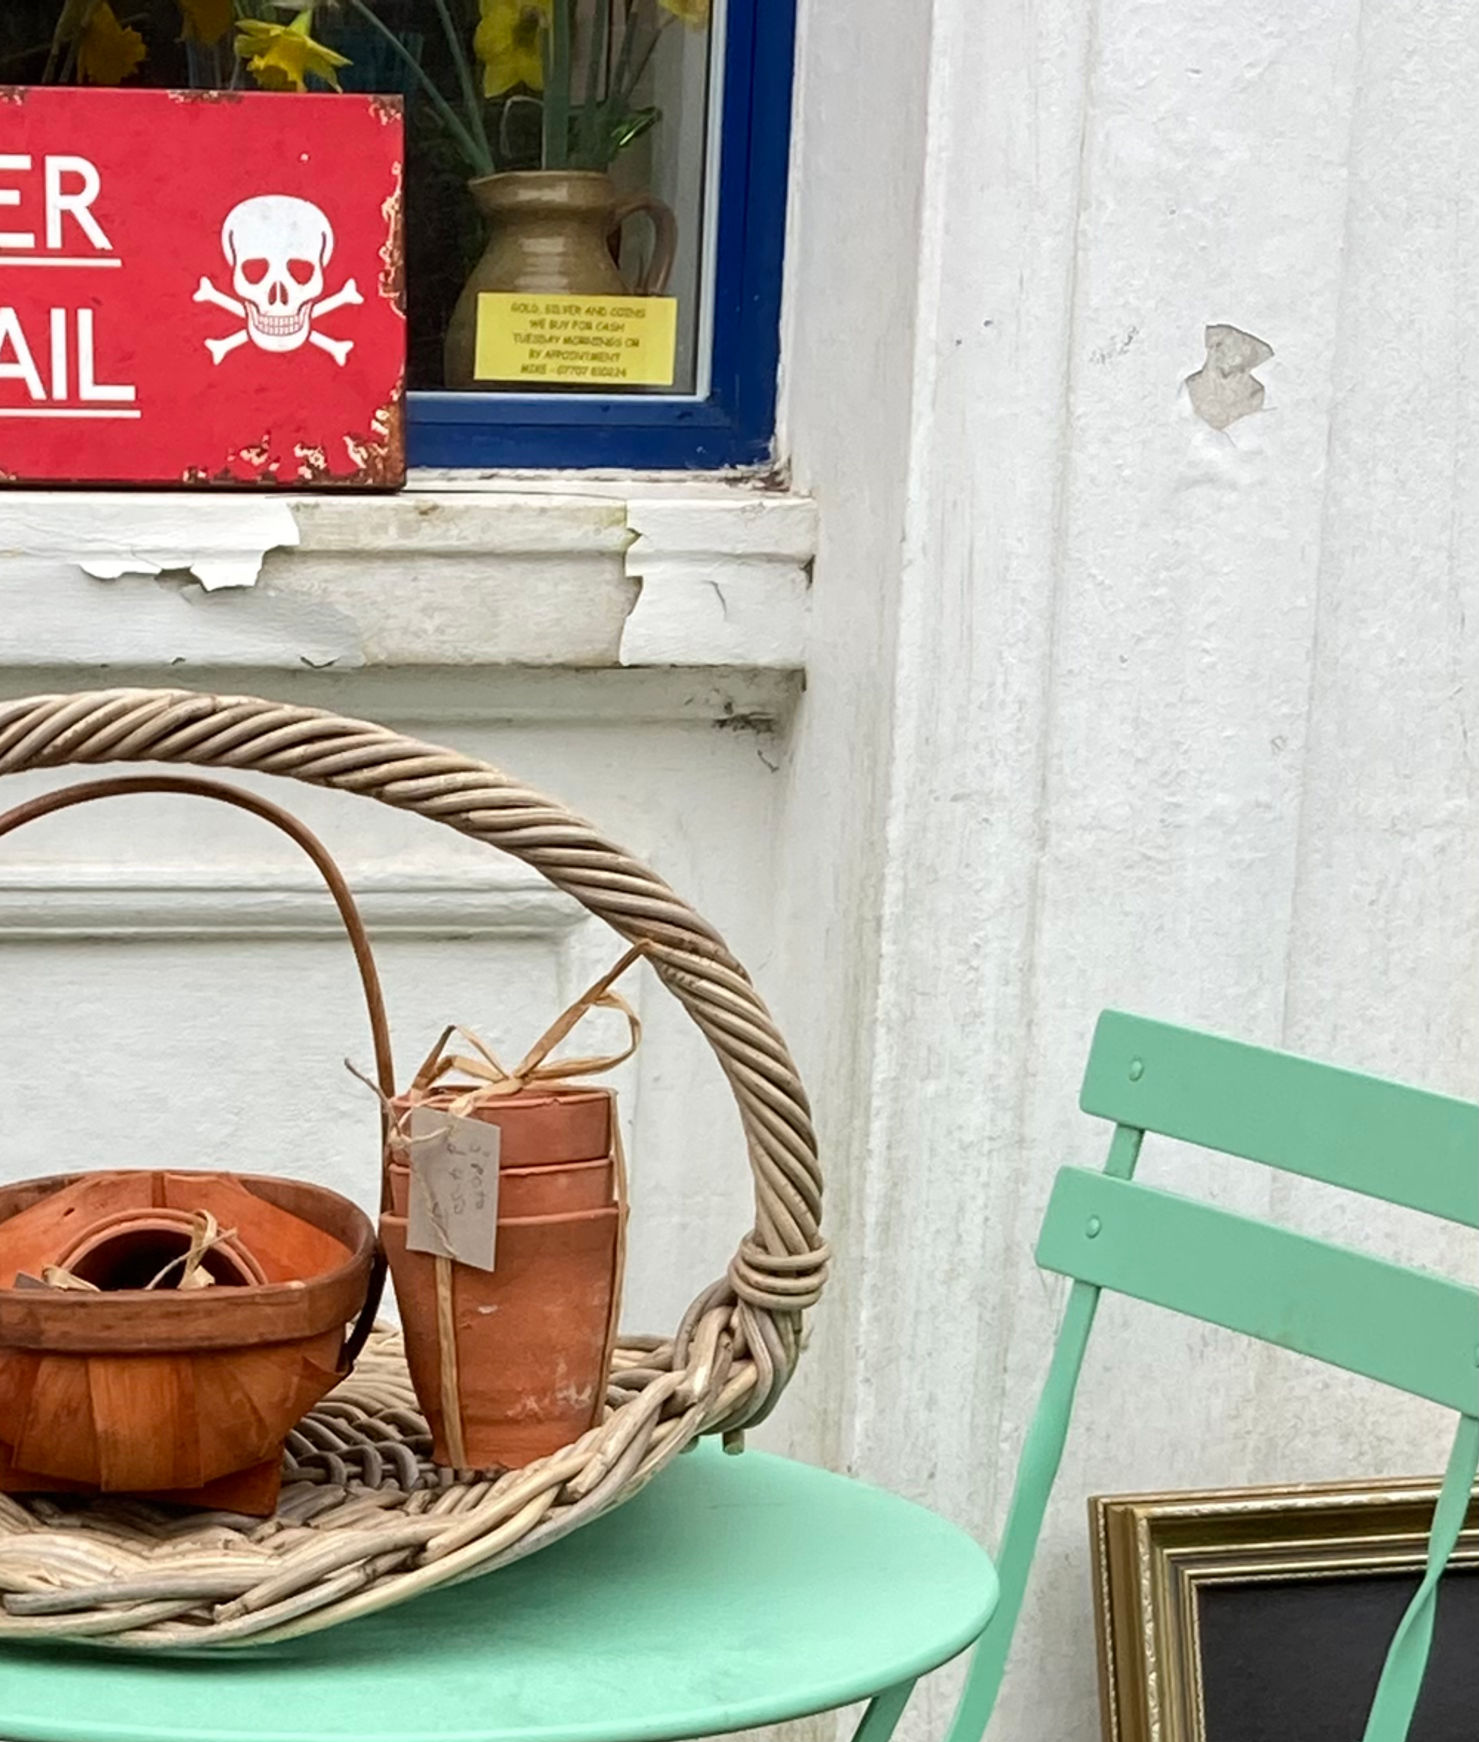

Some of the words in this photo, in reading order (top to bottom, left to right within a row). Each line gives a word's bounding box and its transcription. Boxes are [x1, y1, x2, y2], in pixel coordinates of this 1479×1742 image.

[545, 303, 581, 317] SILVER
[585, 305, 607, 317] AND
[609, 306, 646, 319] COINS
[528, 318, 546, 330] WE
[548, 319, 570, 331] BUY
[571, 319, 593, 332] FOR
[595, 320, 625, 333] CASH
[512, 331, 561, 345] TUESDAY
[528, 347, 542, 360] BY
[543, 349, 622, 363] APPOINTMENT
